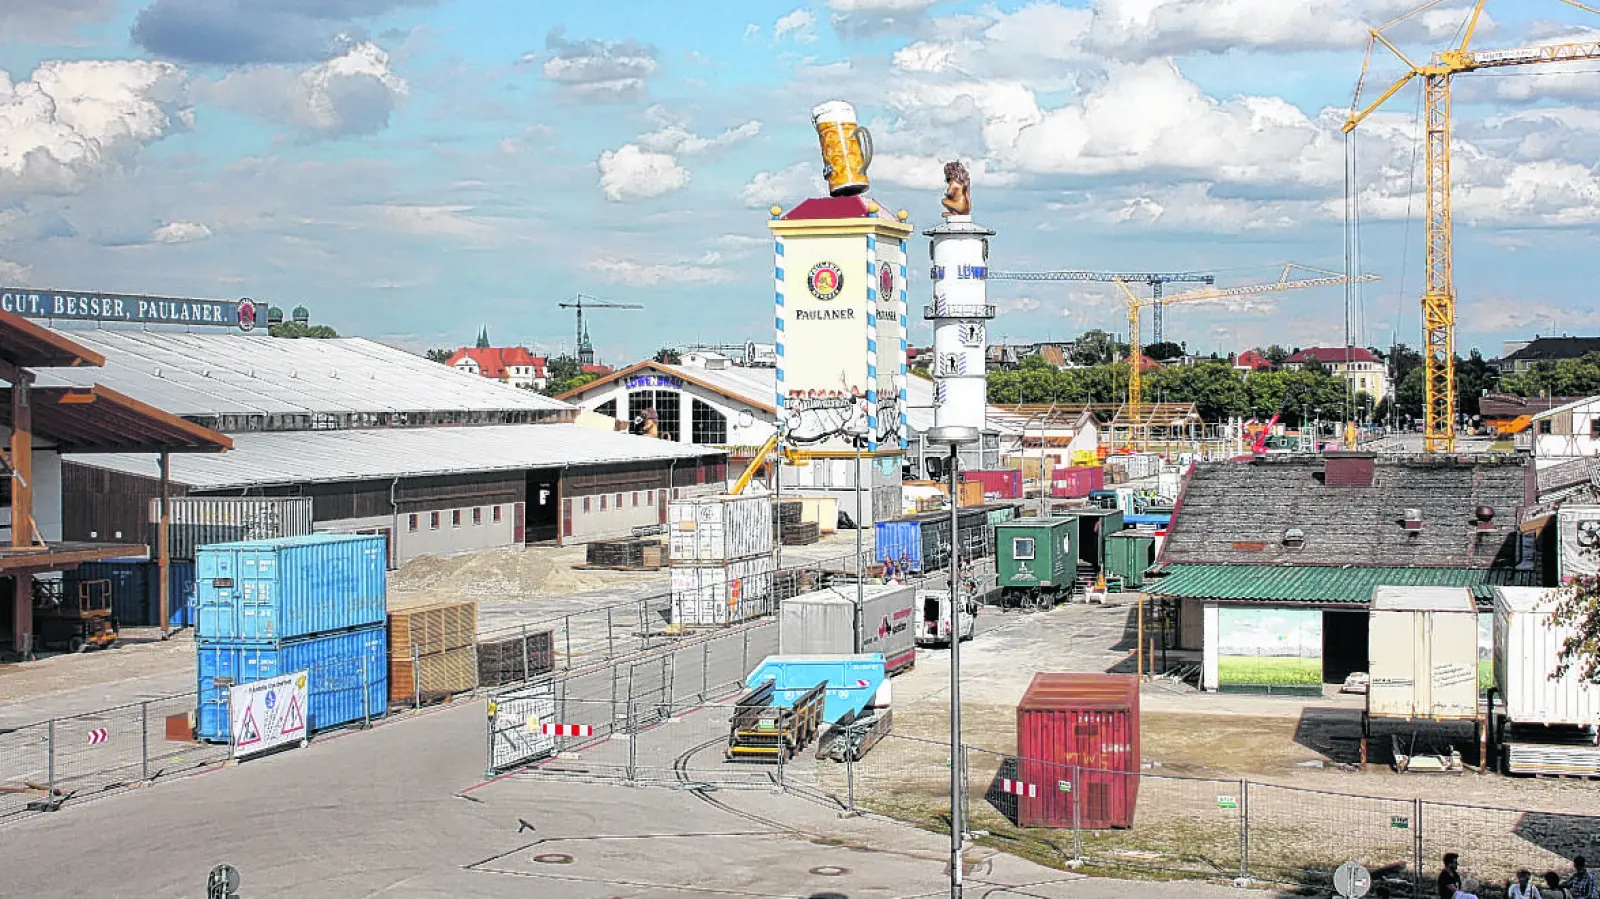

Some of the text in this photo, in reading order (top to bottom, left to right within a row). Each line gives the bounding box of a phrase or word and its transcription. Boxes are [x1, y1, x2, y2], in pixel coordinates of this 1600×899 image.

[2, 293, 44, 316] GUT,
[53, 296, 130, 320] BESSER,
[138, 301, 228, 322] PAULANER.
[796, 308, 855, 320] PAULANER
